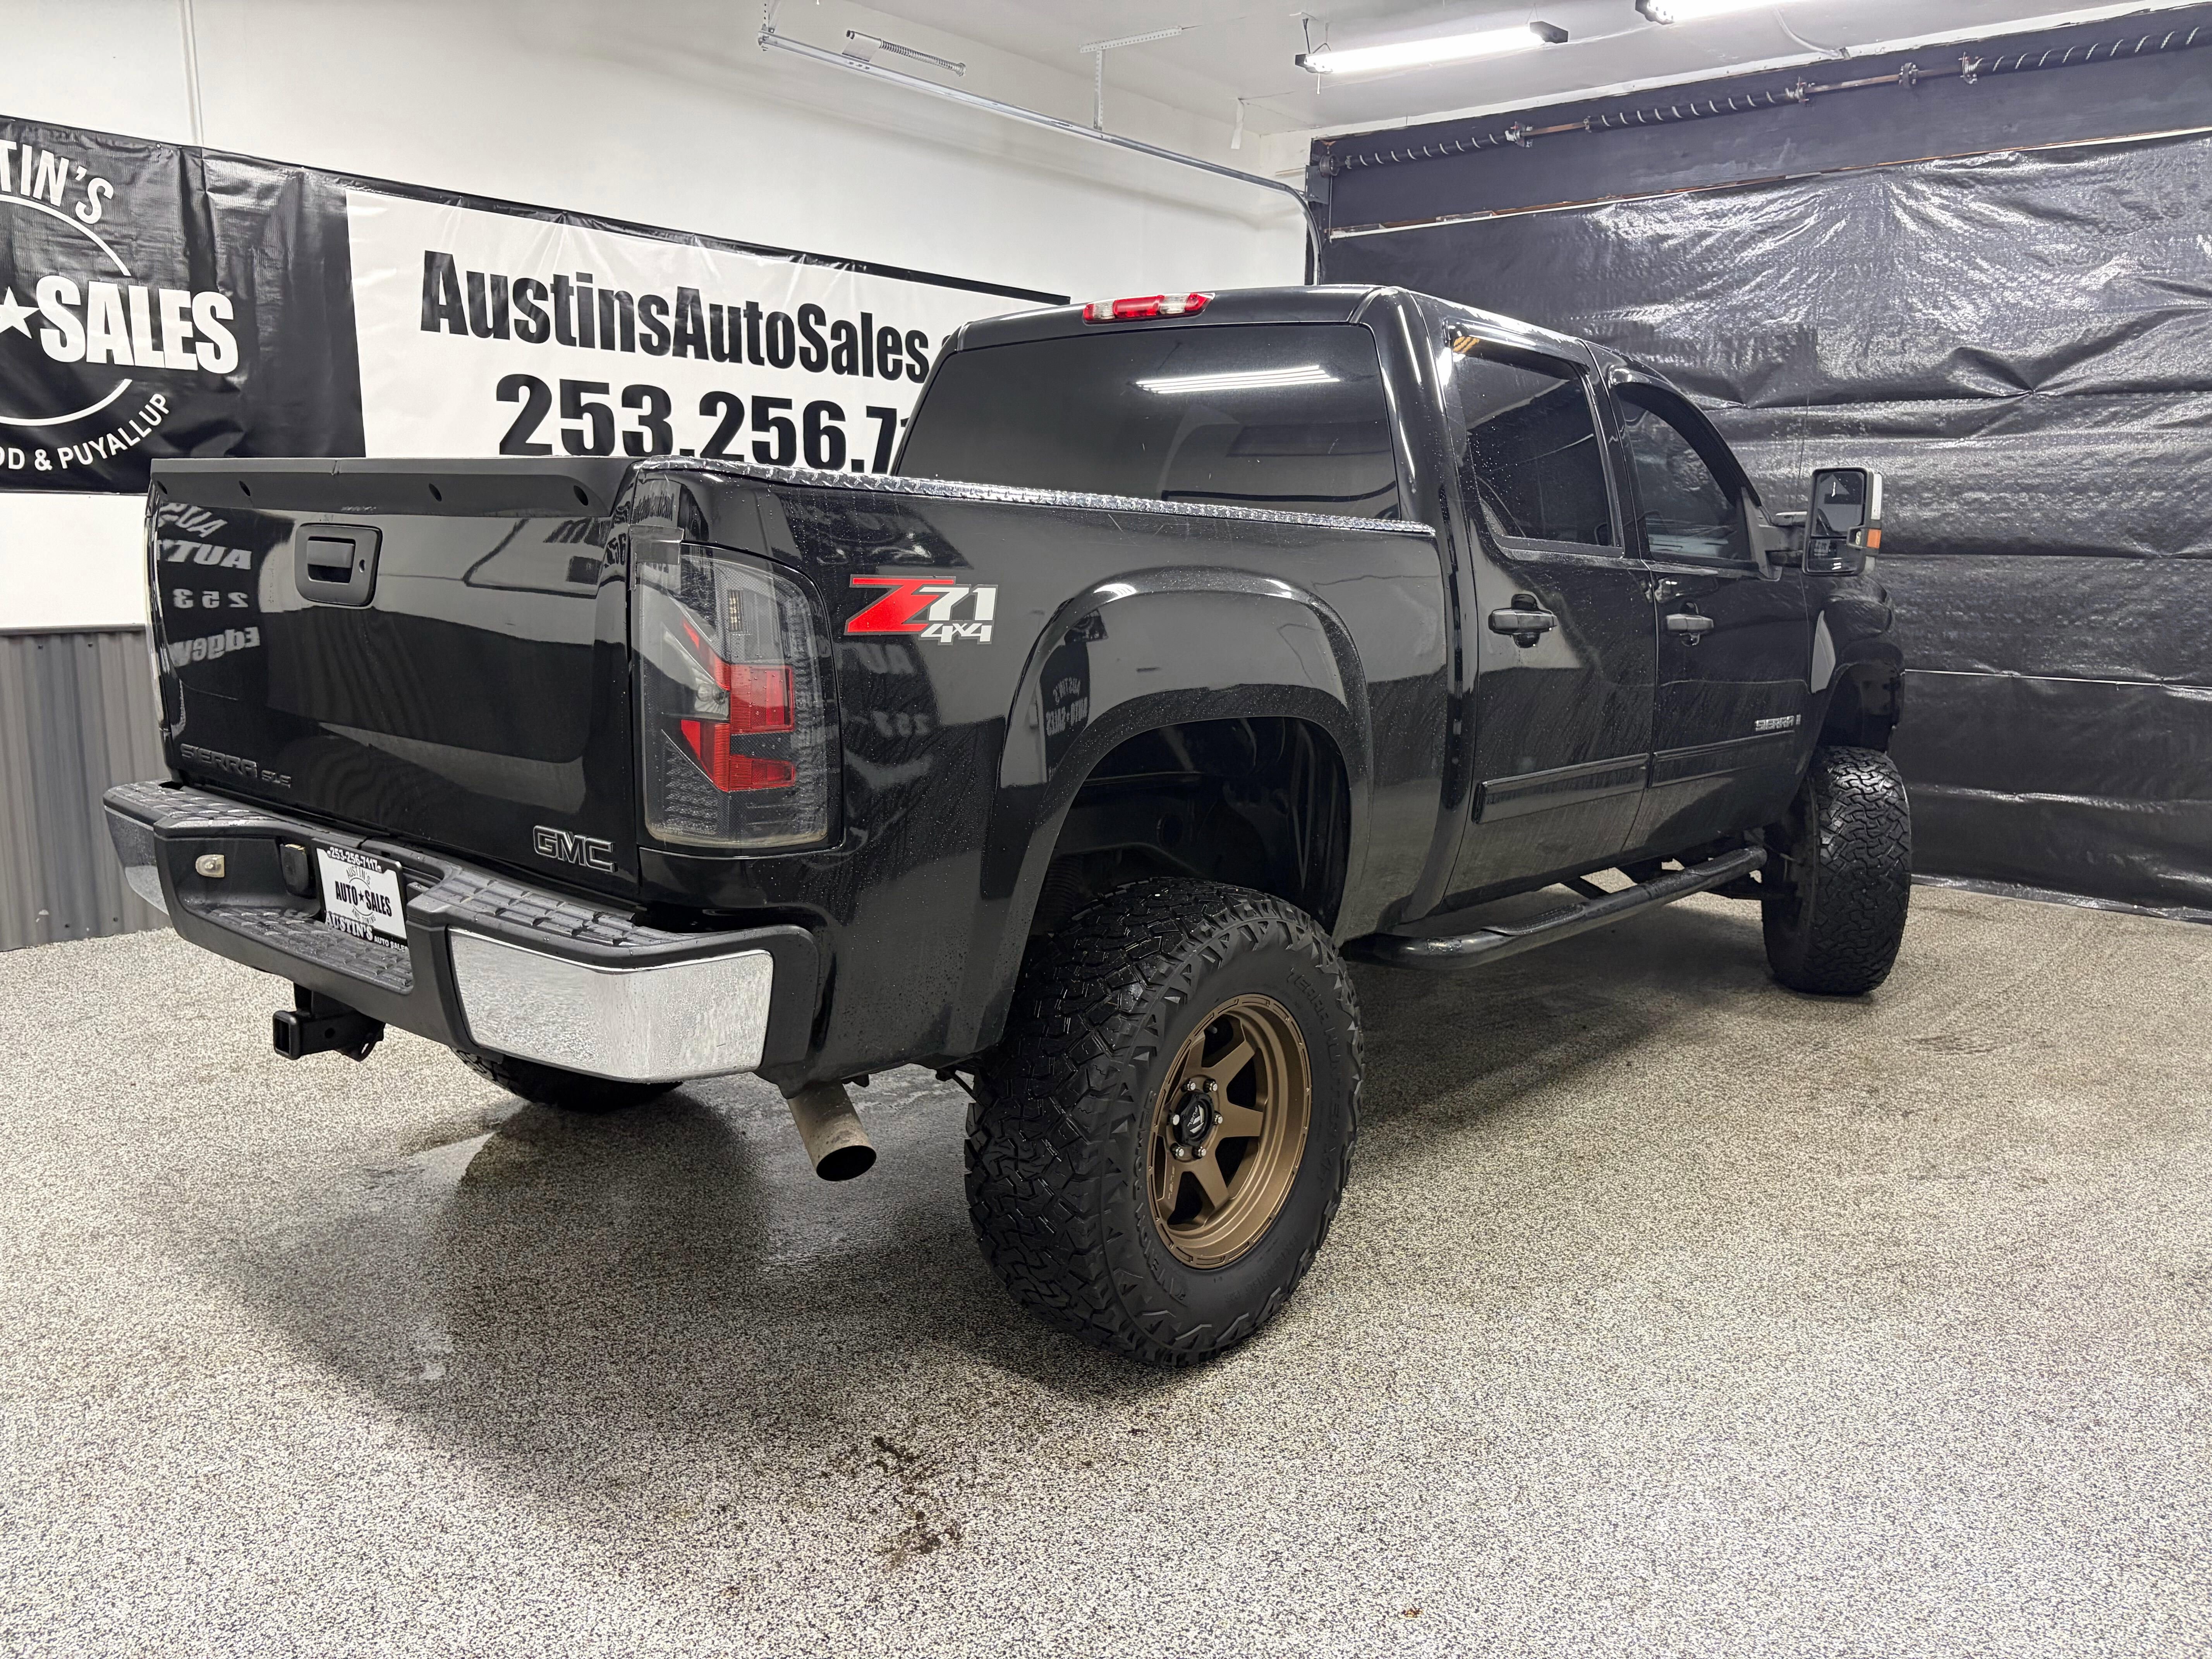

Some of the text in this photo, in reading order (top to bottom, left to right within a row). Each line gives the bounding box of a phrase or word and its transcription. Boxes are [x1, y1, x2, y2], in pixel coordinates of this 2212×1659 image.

[0, 139, 114, 224] TIN'S
[36, 275, 238, 373] SALES
[421, 250, 952, 384] AustinsAutoSales
[34, 449, 53, 471] &
[57, 393, 169, 469] PUYALLUP
[848, 578, 996, 633] Z71
[1755, 716, 1794, 732] SIERRA
[180, 743, 257, 778] SIERRA
[330, 847, 378, 871] 253-256-7117
[533, 825, 617, 873] GMC
[346, 866, 371, 885] AUSTIN'S
[335, 881, 392, 917] AUTO SALES
[352, 908, 360, 920] AND
[325, 911, 373, 941] AUSTIN'S
[374, 936, 389, 947] AUTO
[1187, 1106, 1198, 1127] FUEL
